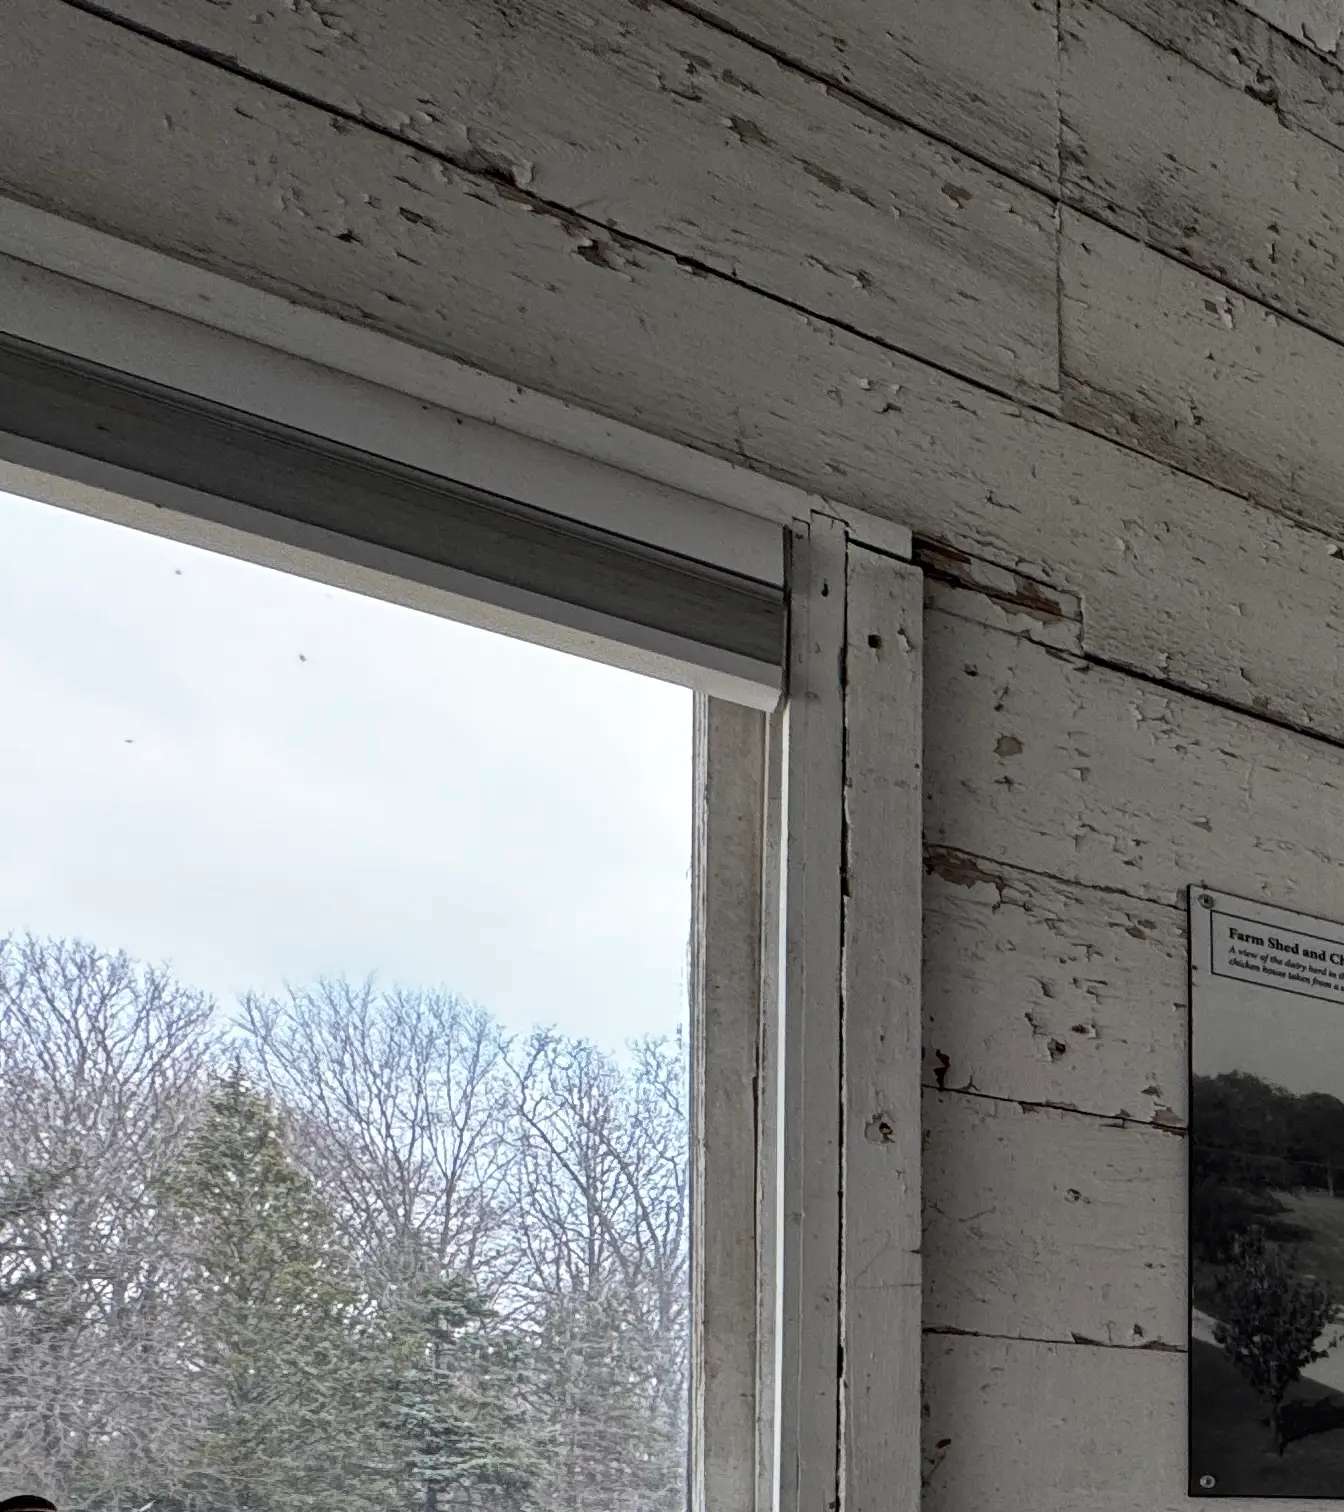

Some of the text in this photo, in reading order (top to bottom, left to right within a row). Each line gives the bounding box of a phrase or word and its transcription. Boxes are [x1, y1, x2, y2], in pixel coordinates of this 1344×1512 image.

[1228, 927, 1264, 947] Farm
[1267, 937, 1300, 955] Shed
[1302, 948, 1326, 962] and
[1228, 945, 1236, 955] A
[1237, 948, 1258, 959] view
[1260, 953, 1269, 963] of
[1270, 955, 1283, 965] the
[1284, 959, 1307, 972] dairy
[1308, 964, 1327, 976] herd
[1328, 969, 1337, 978] in
[1228, 957, 1261, 972] chicken
[1288, 972, 1310, 984] taken
[1311, 976, 1332, 989] from
